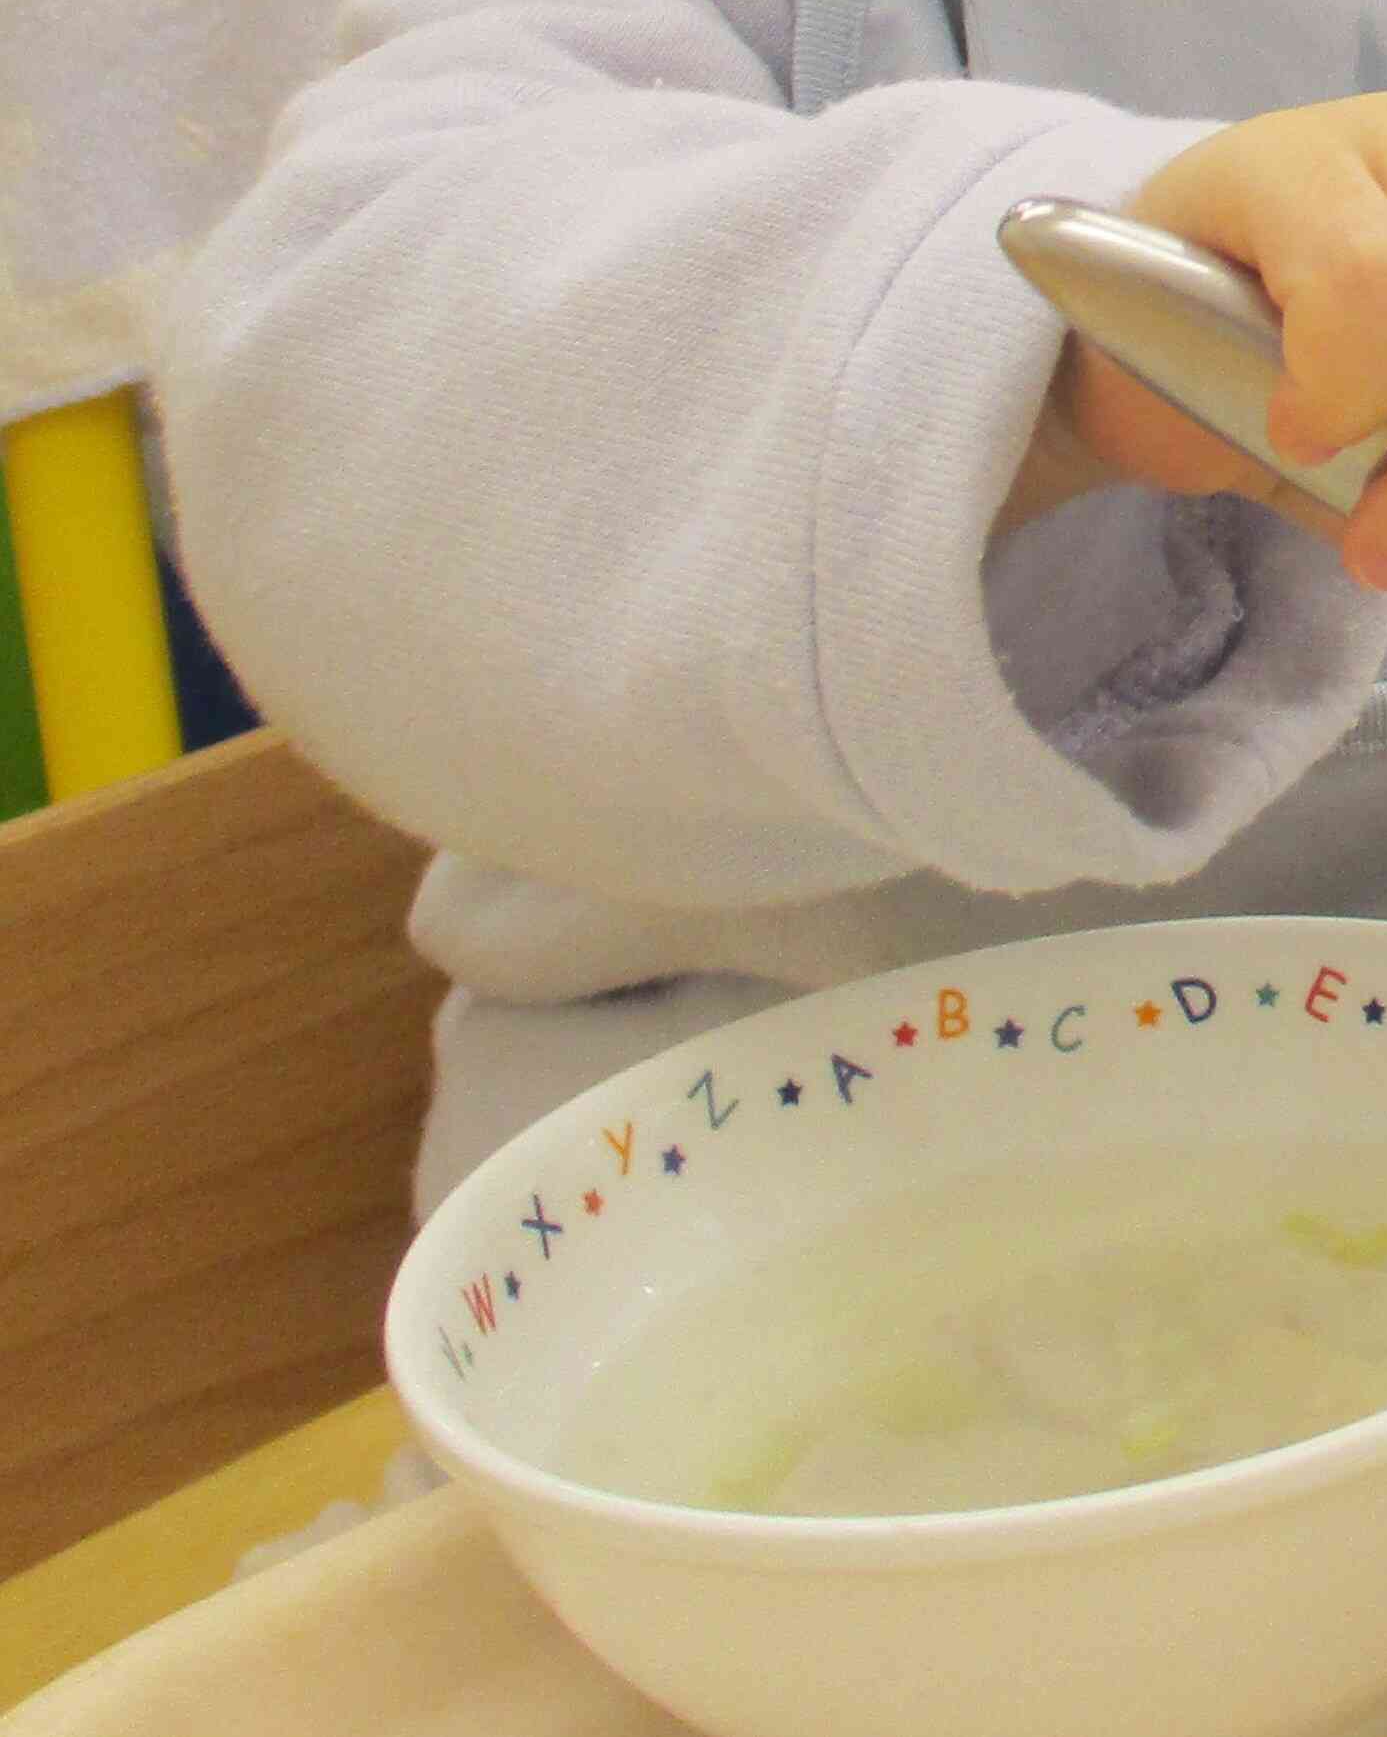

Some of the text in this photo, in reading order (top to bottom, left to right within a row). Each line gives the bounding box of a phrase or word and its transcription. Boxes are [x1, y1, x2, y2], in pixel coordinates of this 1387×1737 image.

[462, 1272, 496, 1335] W
[521, 1193, 563, 1261] X
[602, 1121, 635, 1176] Y
[687, 1070, 740, 1131] Z
[831, 1053, 874, 1104] A
[937, 988, 970, 1039] B
[1051, 1005, 1087, 1053] C
[1170, 977, 1217, 1024] D
[1304, 965, 1348, 1023] E
